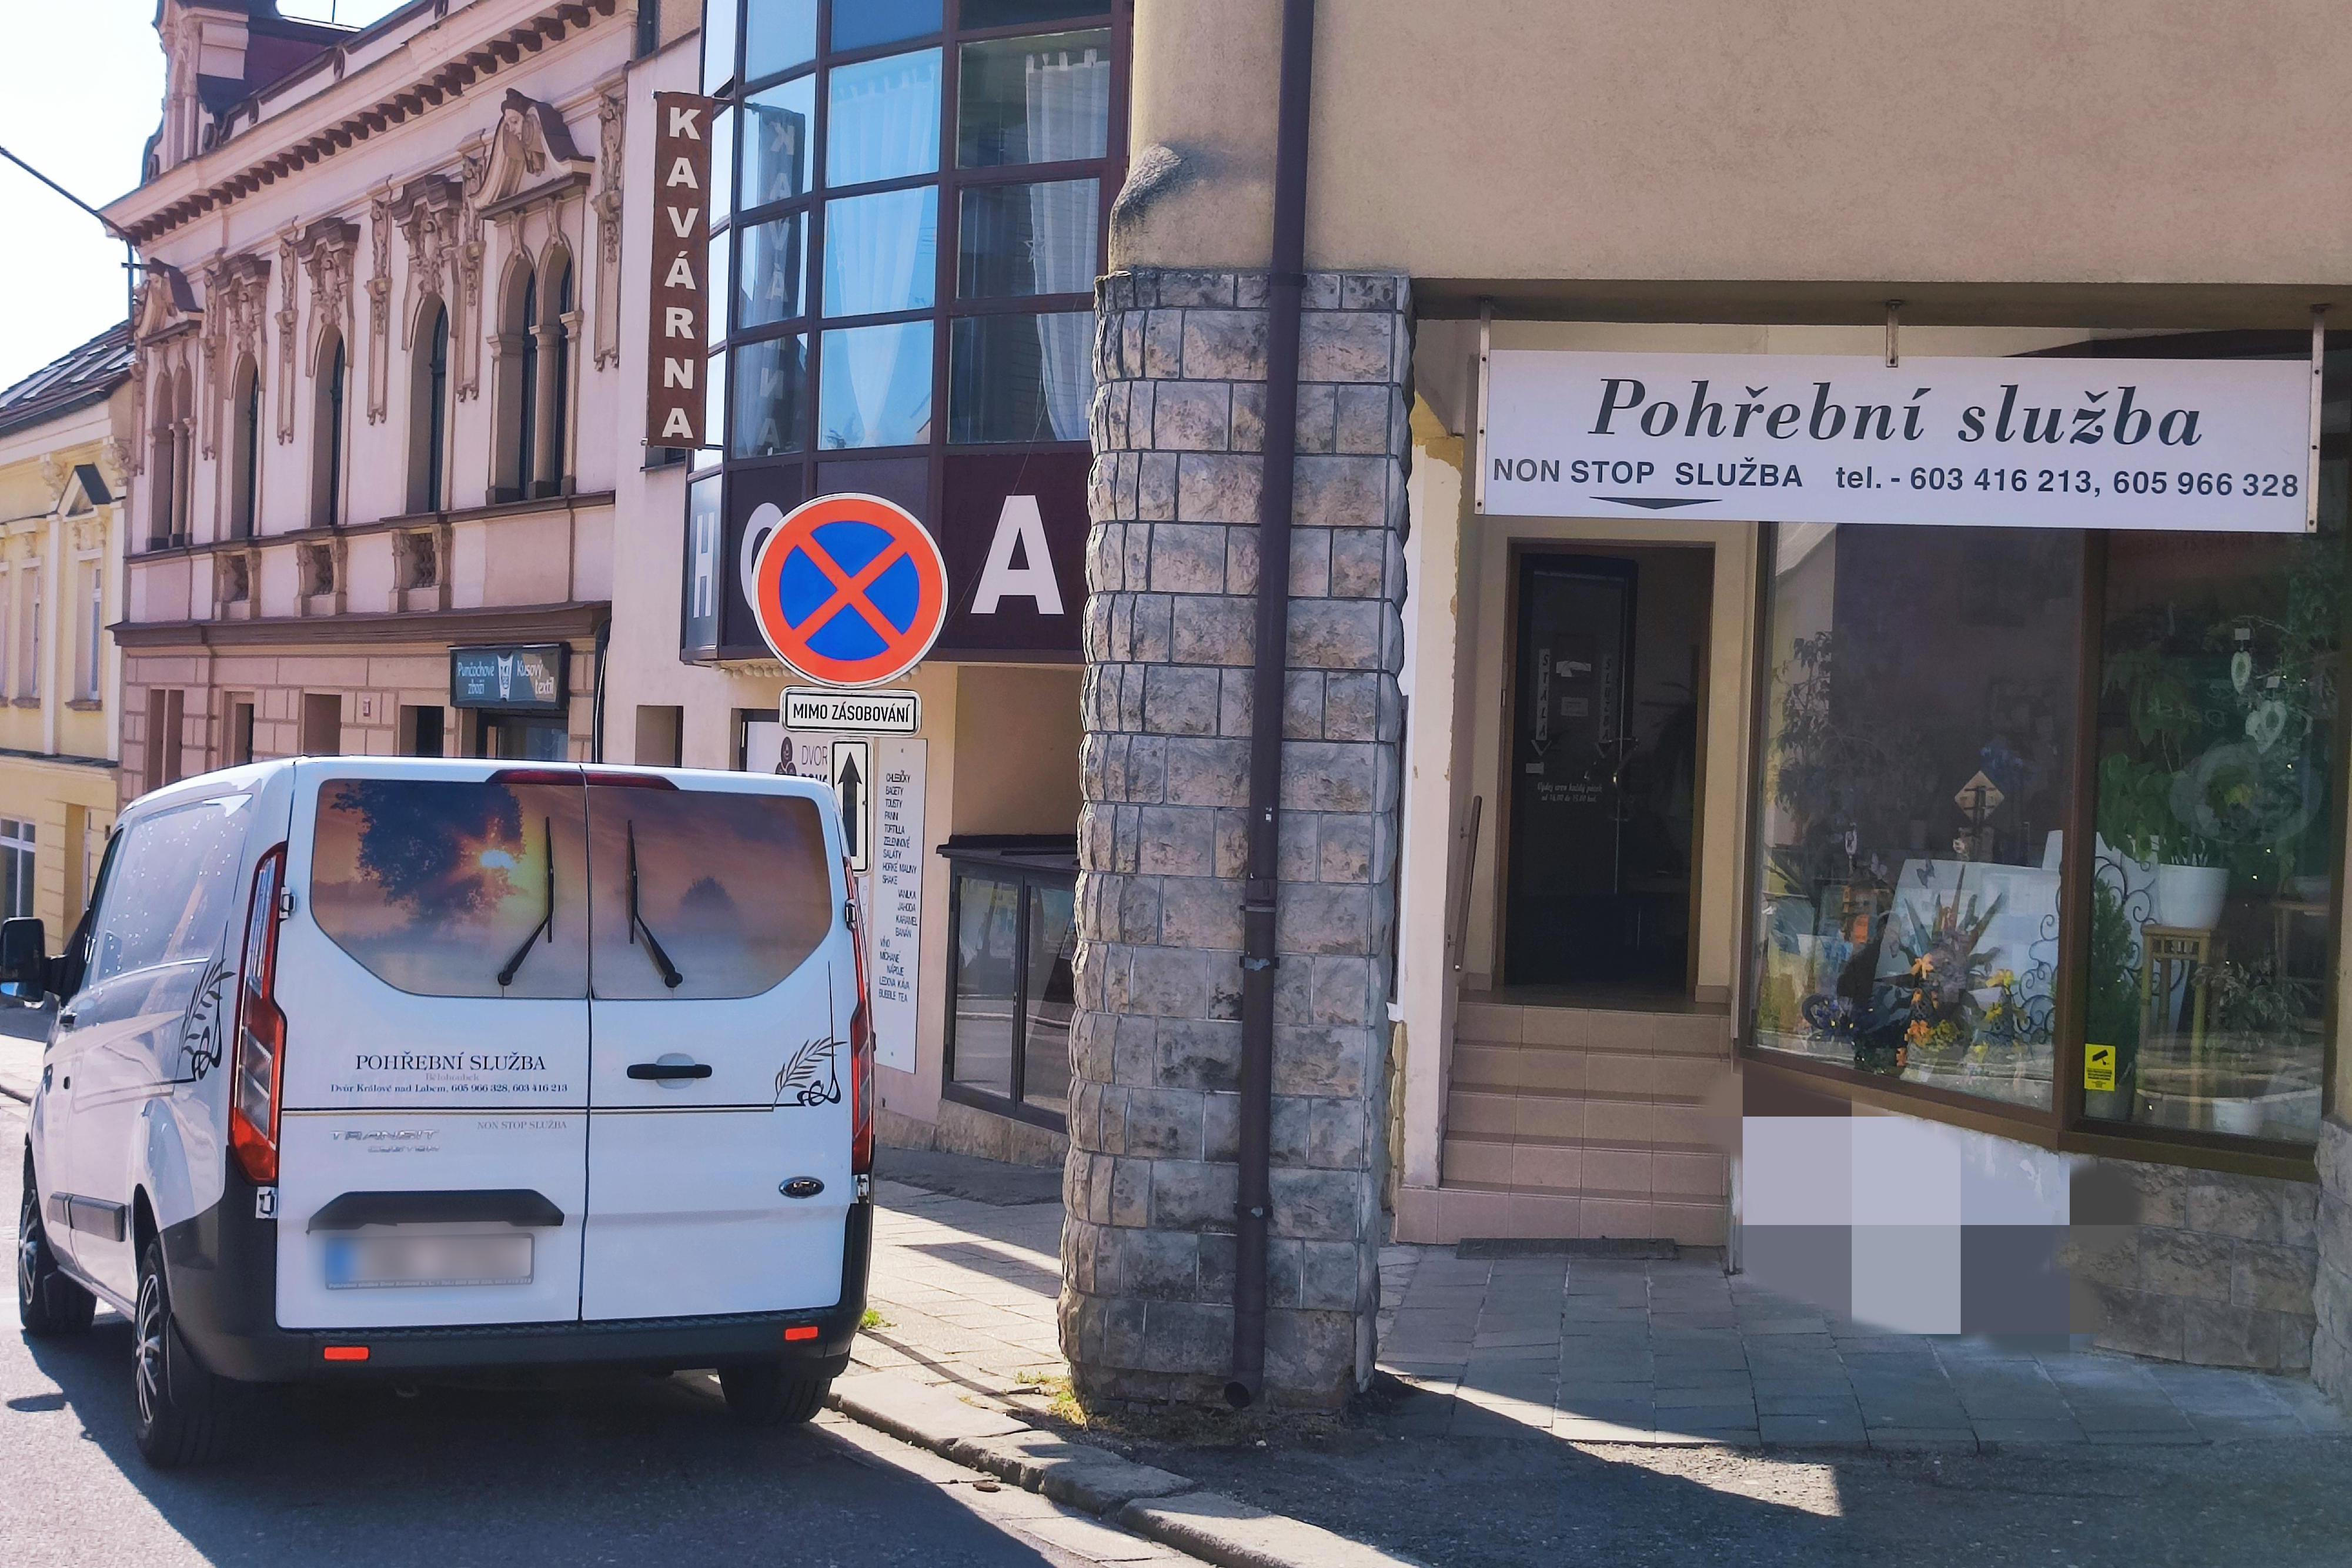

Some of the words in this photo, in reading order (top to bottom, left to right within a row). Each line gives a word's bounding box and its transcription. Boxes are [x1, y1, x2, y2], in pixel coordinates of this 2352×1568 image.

[662, 106, 701, 439] KAVÁRNA
[1587, 377, 1925, 443] Pohřební
[1957, 385, 2204, 447] služba
[1493, 458, 1560, 482] NON
[1571, 460, 1655, 484] STOP
[1675, 457, 1803, 487] SLUŽBA
[1836, 466, 1882, 490] tel.
[1909, 467, 1963, 491] 603
[1974, 468, 2028, 492] 416
[2037, 469, 2102, 497] 213,
[2113, 471, 2167, 494] 605
[2177, 472, 2233, 496] 966
[2241, 474, 2298, 497] 328
[517, 659, 544, 678] Kusový
[535, 676, 554, 694] textil
[793, 703, 828, 719] MIMO
[831, 701, 911, 723] ZÁSOBOVÁNÍ
[886, 785, 904, 795] BAGETY
[885, 798, 903, 808] TOUSTY
[884, 824, 905, 834] TORTILLA
[883, 847, 902, 860] SALÁTY
[897, 901, 916, 912] JAHODA
[896, 915, 918, 926] KARAMEL
[879, 988, 896, 1000] BUBBLE
[898, 992, 908, 1002] TEA
[355, 1051, 465, 1071] POHŘEBNÍ
[470, 1051, 546, 1071] SLUŽBA
[330, 1084, 354, 1092] Dvůr
[357, 1084, 392, 1092] Králové
[395, 1084, 412, 1092] nad
[451, 1084, 469, 1092] 605
[471, 1084, 488, 1092] 966
[513, 1084, 529, 1092] 603
[532, 1084, 549, 1092] 416
[551, 1084, 568, 1092] 213
[477, 1121, 499, 1129] NON
[501, 1121, 527, 1129] STOP
[530, 1119, 567, 1129] SLUŽBA
[329, 1129, 440, 1141] TRANSIT
